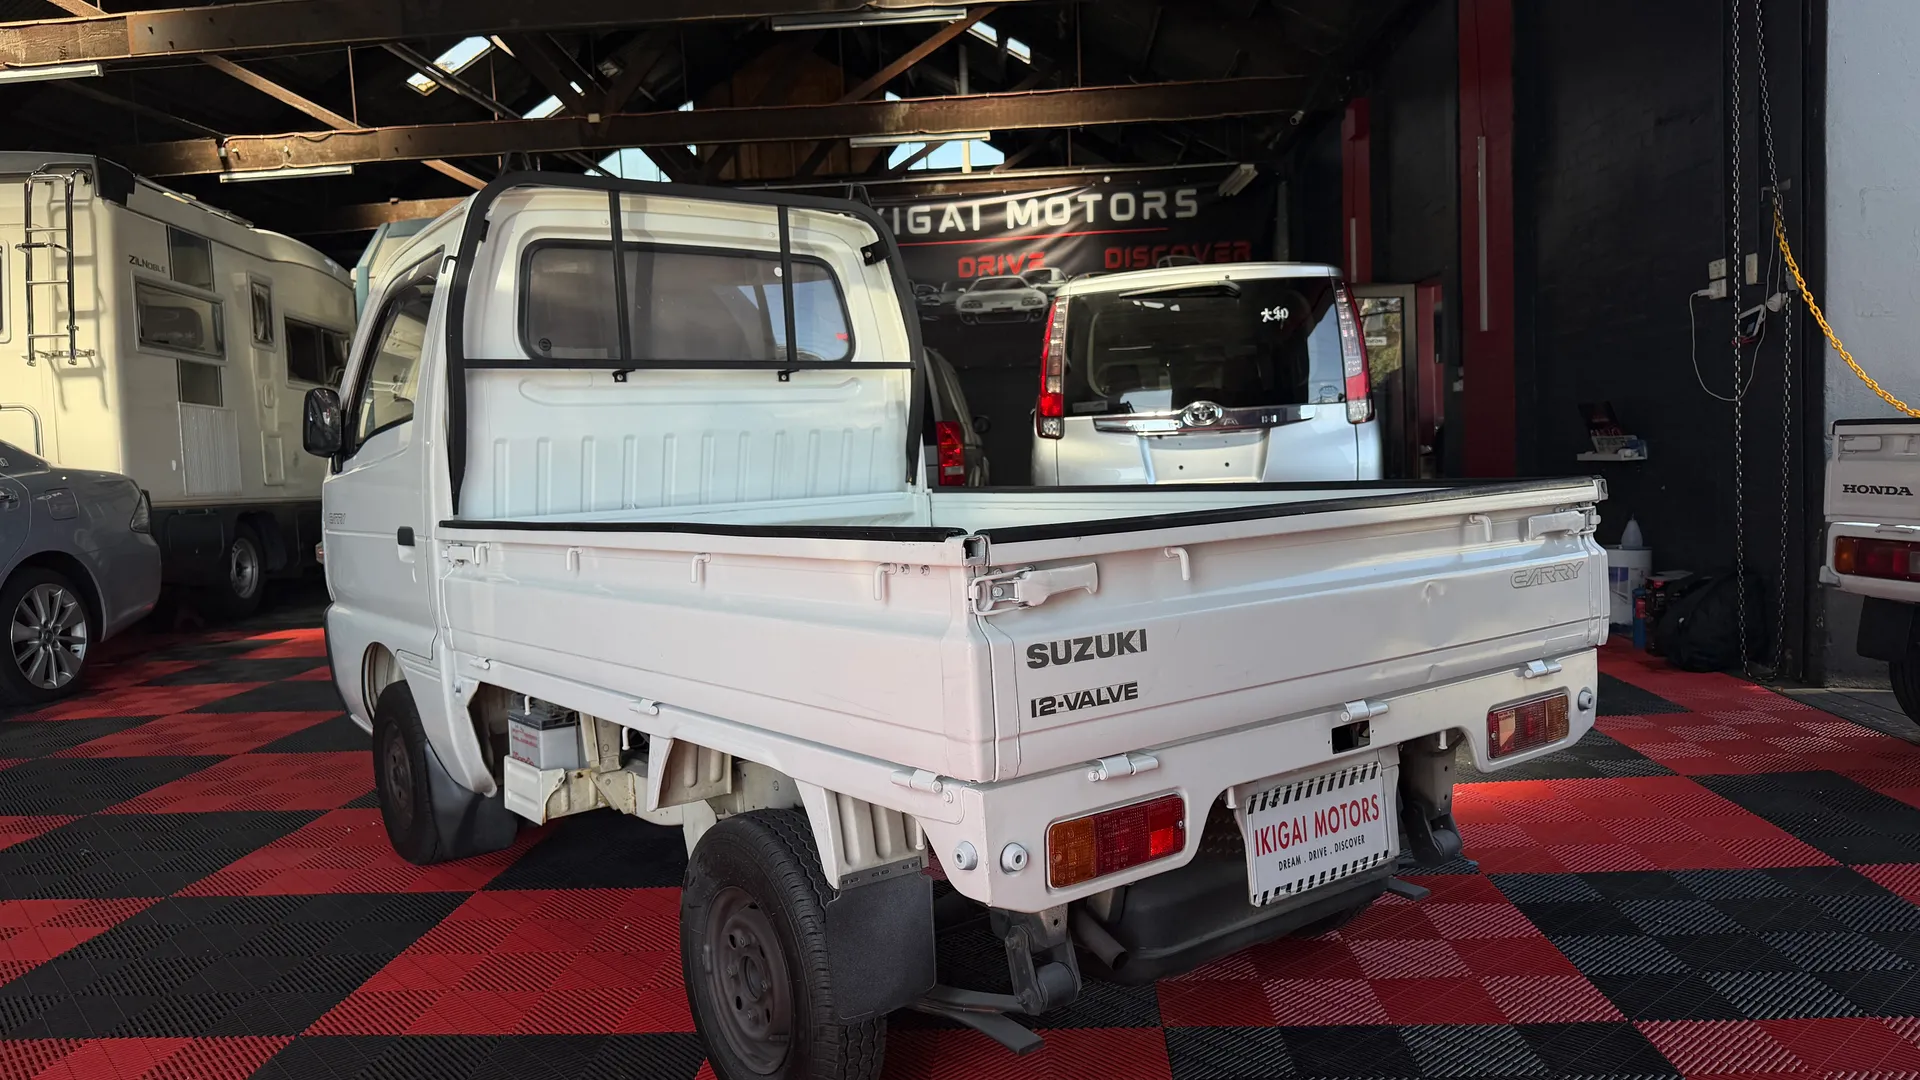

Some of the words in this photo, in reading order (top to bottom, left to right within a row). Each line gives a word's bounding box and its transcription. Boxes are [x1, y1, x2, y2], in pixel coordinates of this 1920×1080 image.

[877, 202, 981, 234] IGAI
[1006, 188, 1198, 229] MOTORS
[958, 252, 1044, 278] DRIVE
[1842, 484, 1914, 496] HONDA
[1510, 561, 1584, 589] CARRY
[1026, 628, 1148, 669] SUZUKI
[1255, 815, 1308, 857] IKIGAI
[1314, 793, 1380, 839] MOTORS
[1278, 855, 1301, 871] DREAM
[1308, 846, 1328, 861] DRIVE
[1334, 834, 1366, 853] DISCOVER
